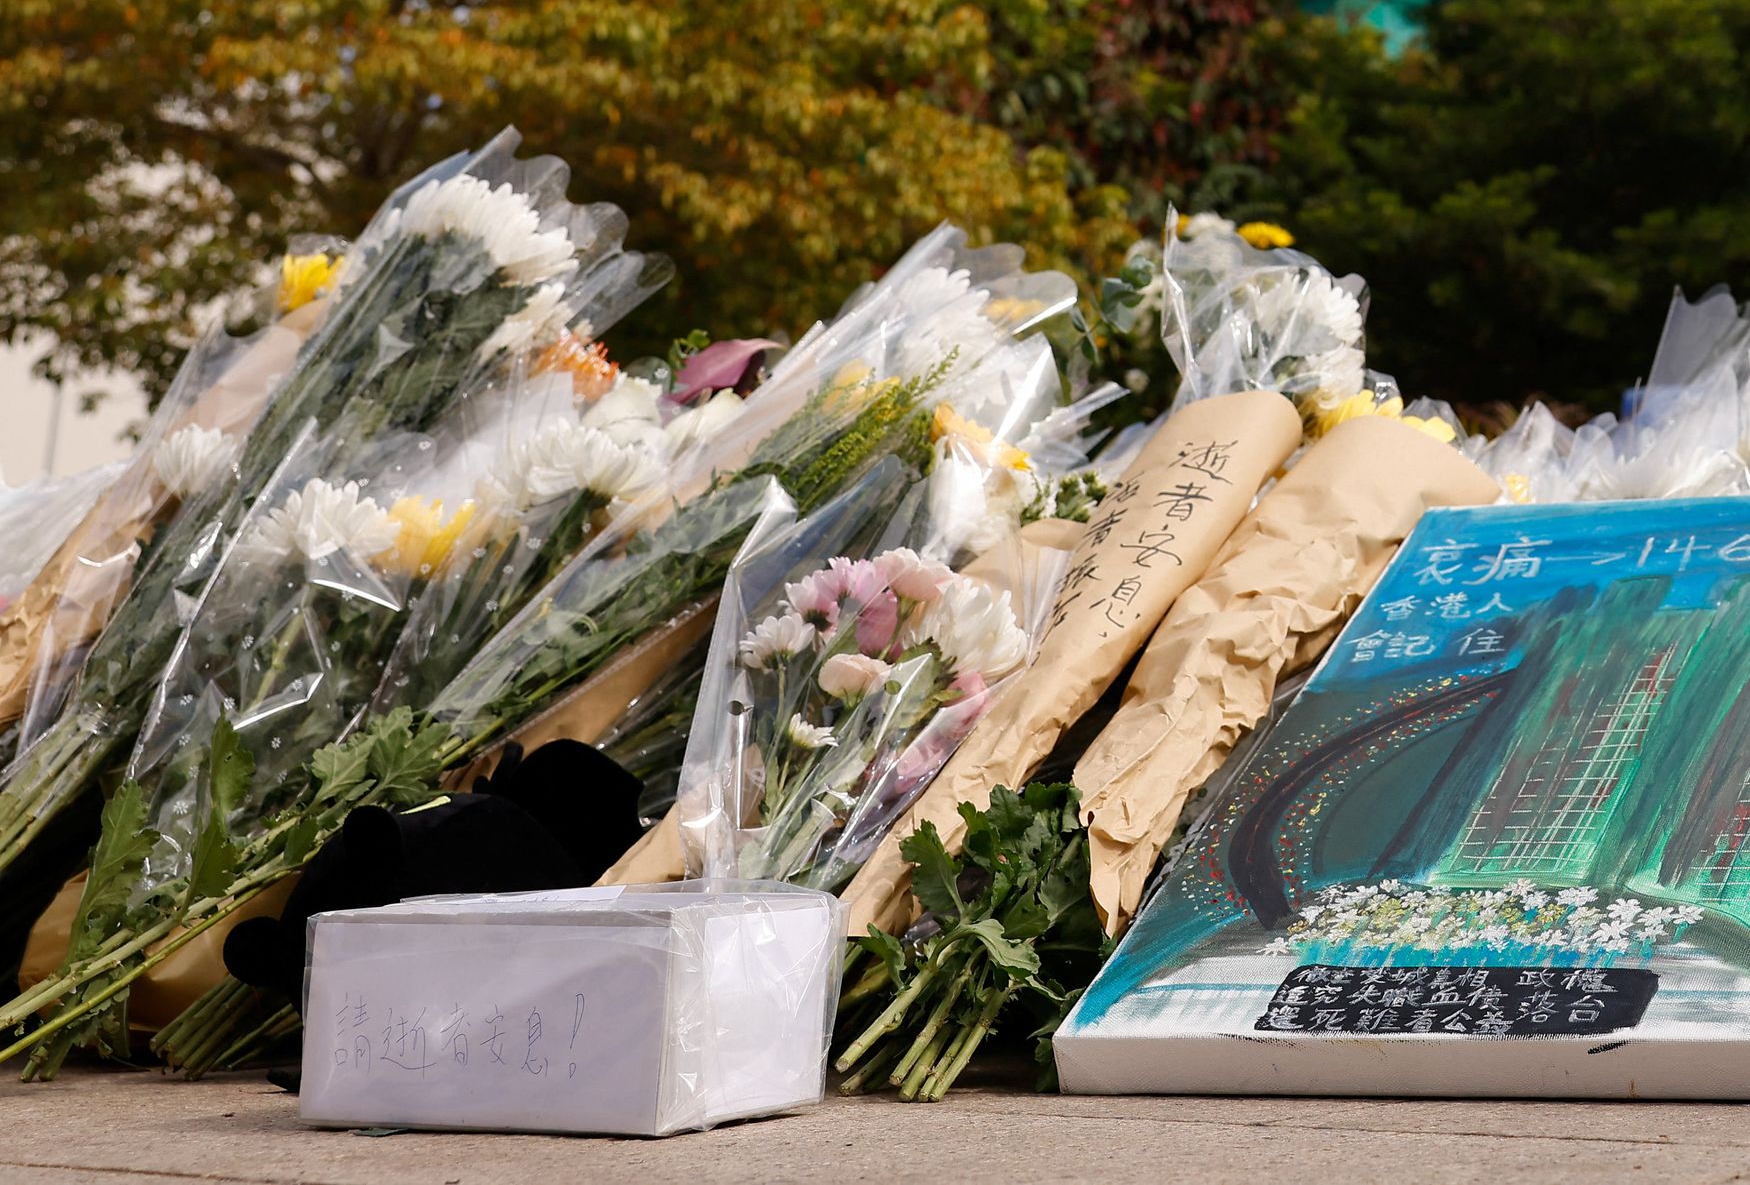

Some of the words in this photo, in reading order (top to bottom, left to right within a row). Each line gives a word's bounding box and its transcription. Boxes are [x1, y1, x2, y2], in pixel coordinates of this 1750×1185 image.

[1411, 535, 1553, 586] 哀痛
[1380, 590, 1513, 621] 香港人
[1346, 628, 1505, 663] 會記住
